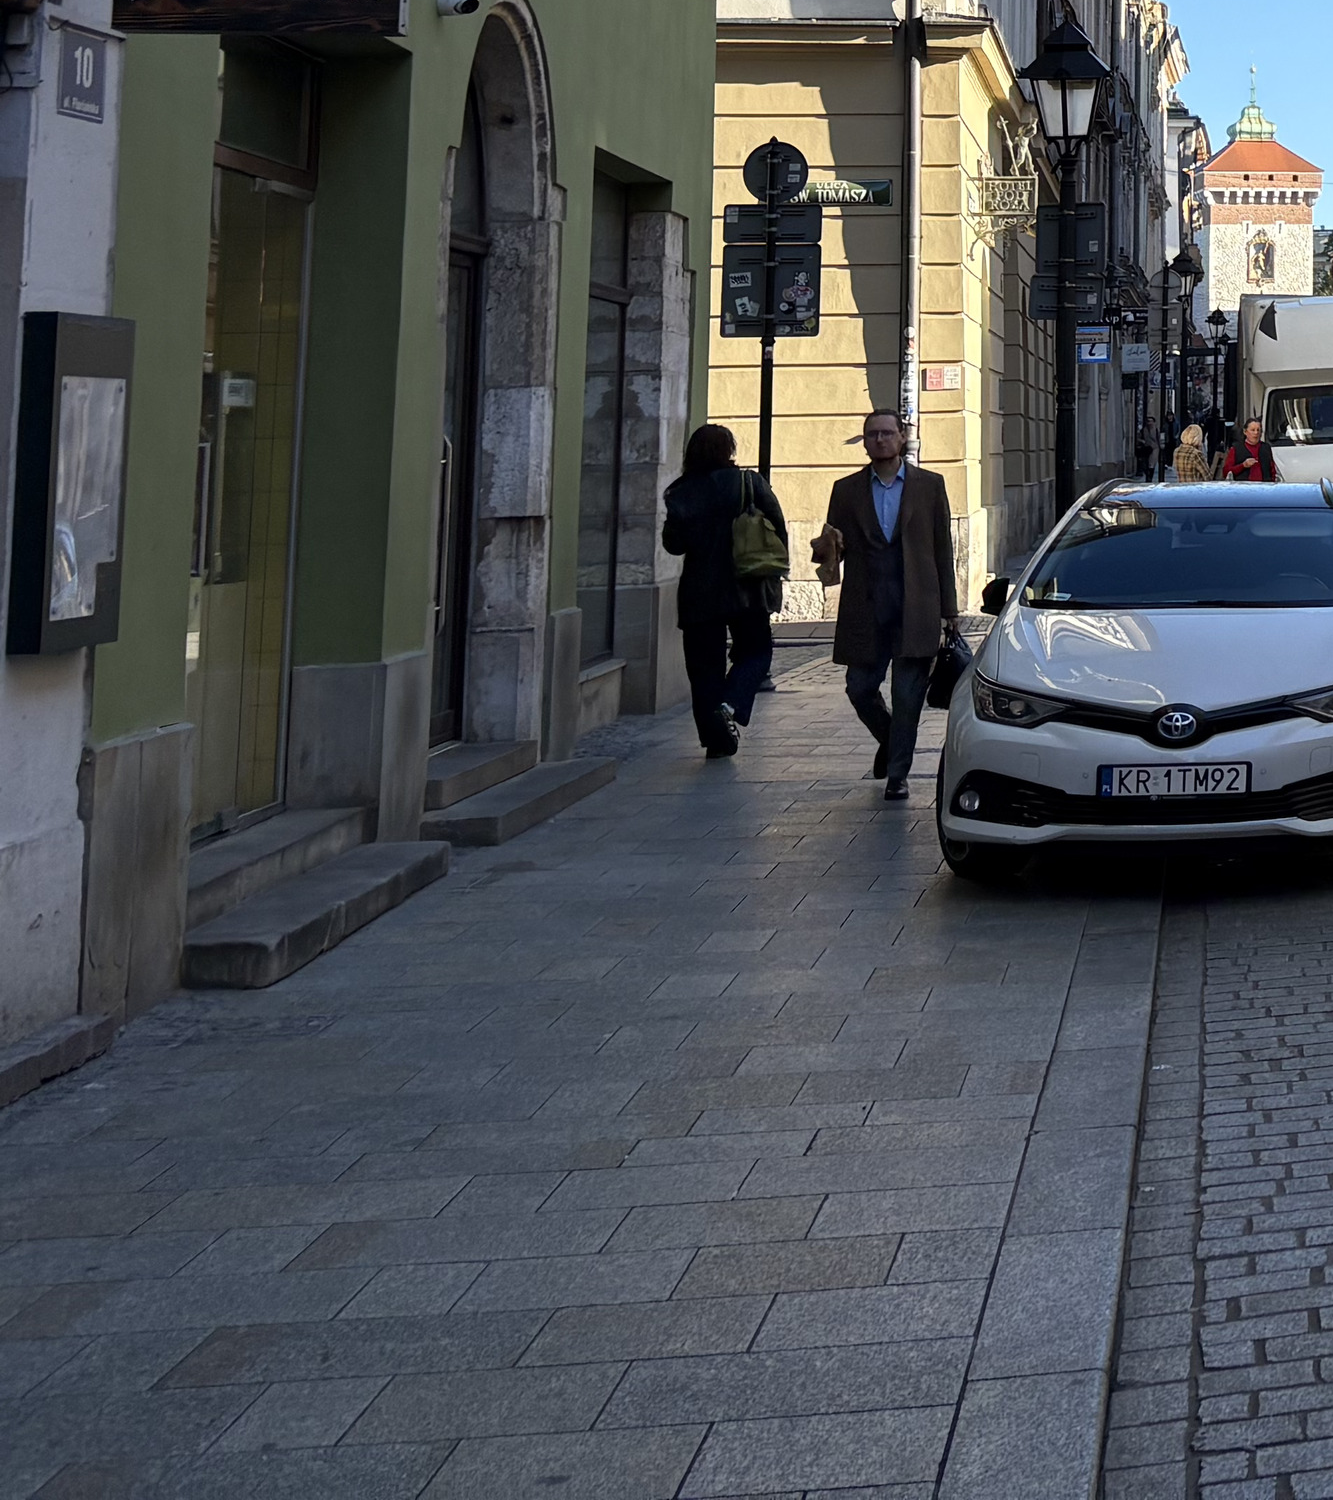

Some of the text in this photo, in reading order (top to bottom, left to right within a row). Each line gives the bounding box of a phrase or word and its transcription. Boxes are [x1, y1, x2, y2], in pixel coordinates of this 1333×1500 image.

[74, 46, 94, 88] 10
[816, 189, 874, 203] TOMASZA
[1118, 767, 1240, 794] KR 1TM92
